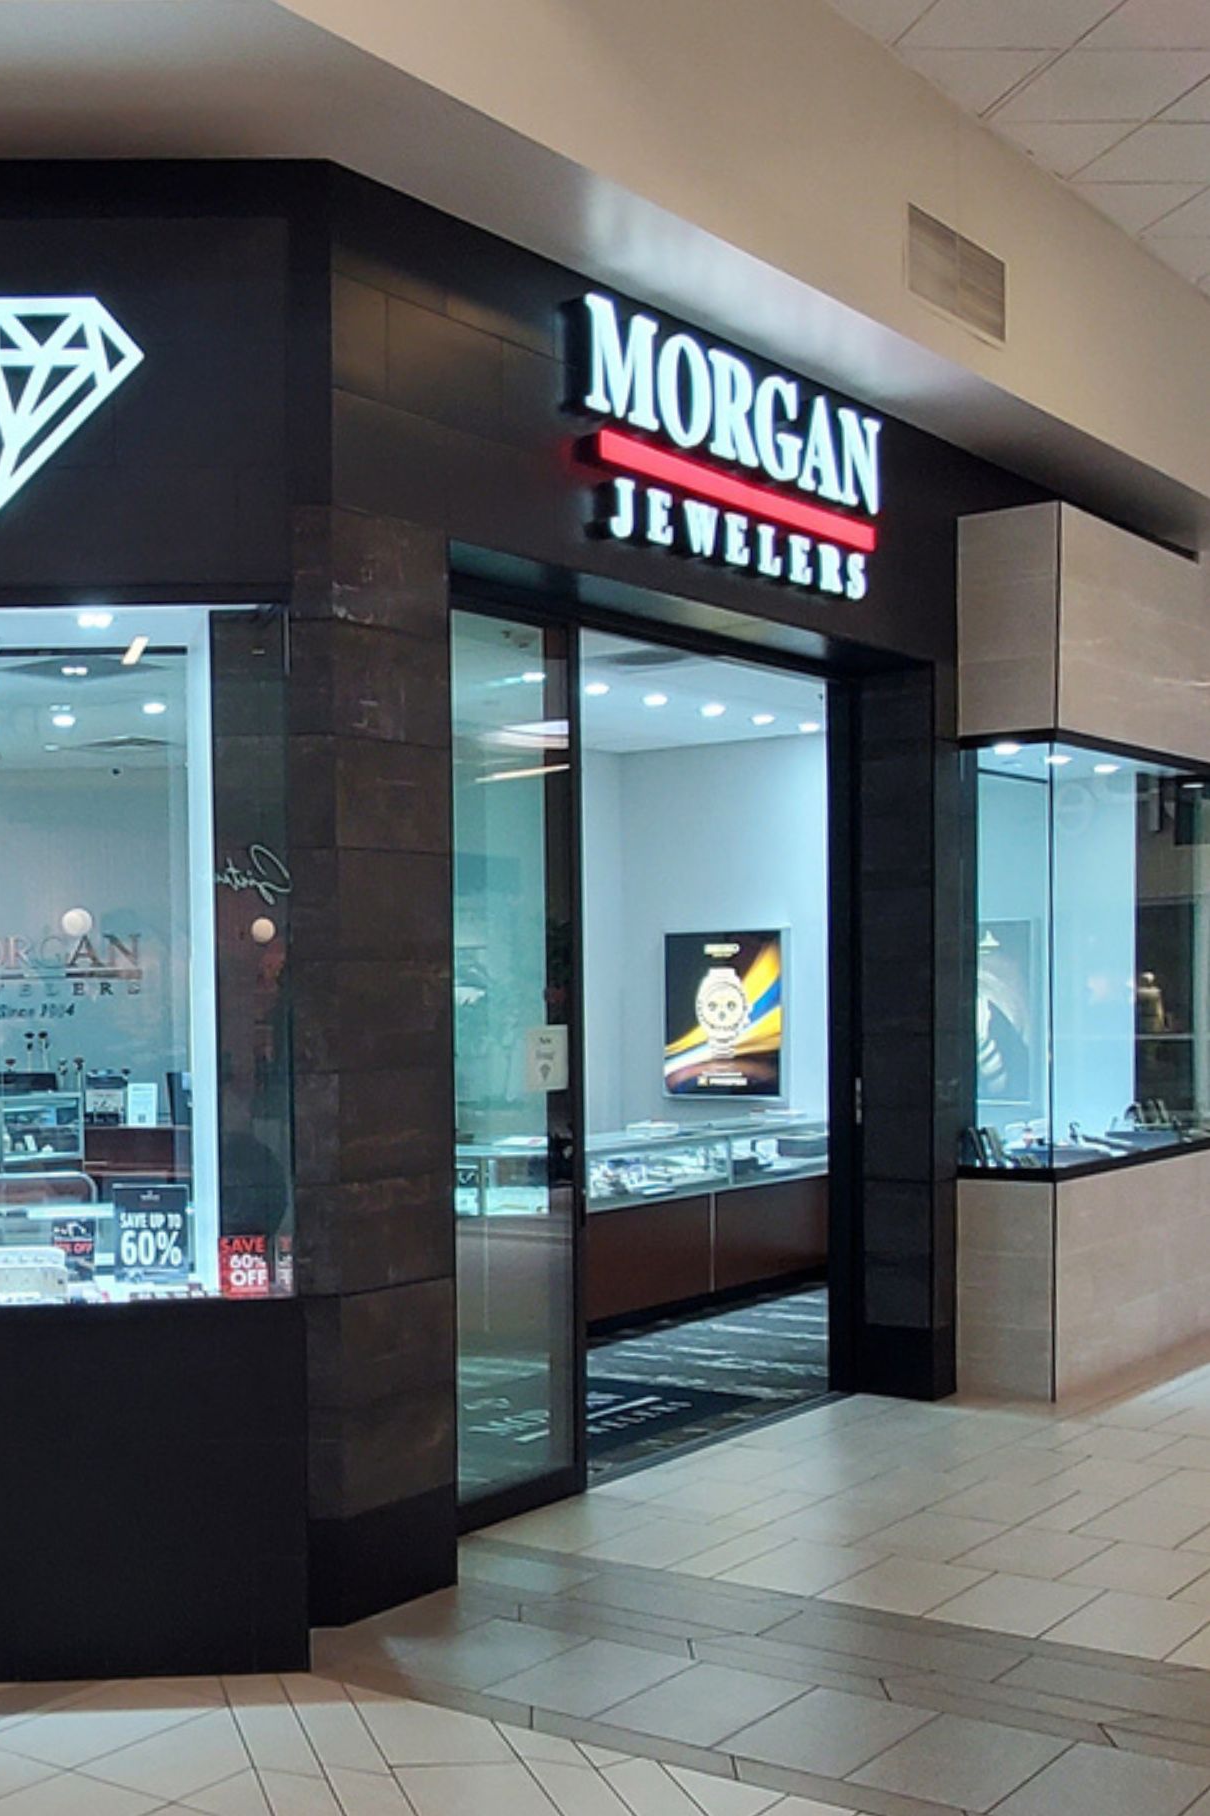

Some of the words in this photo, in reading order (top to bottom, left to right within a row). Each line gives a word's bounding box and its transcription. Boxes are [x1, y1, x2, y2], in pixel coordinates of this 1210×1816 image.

[584, 292, 882, 516] MORGAN
[609, 476, 868, 601] JEWELERS
[119, 1211, 147, 1229] SAVE
[149, 1211, 166, 1230] UP
[121, 1229, 183, 1267] 60%
[219, 1235, 266, 1253] SAVE
[230, 1253, 267, 1269] 60%
[230, 1269, 269, 1286] OFF
